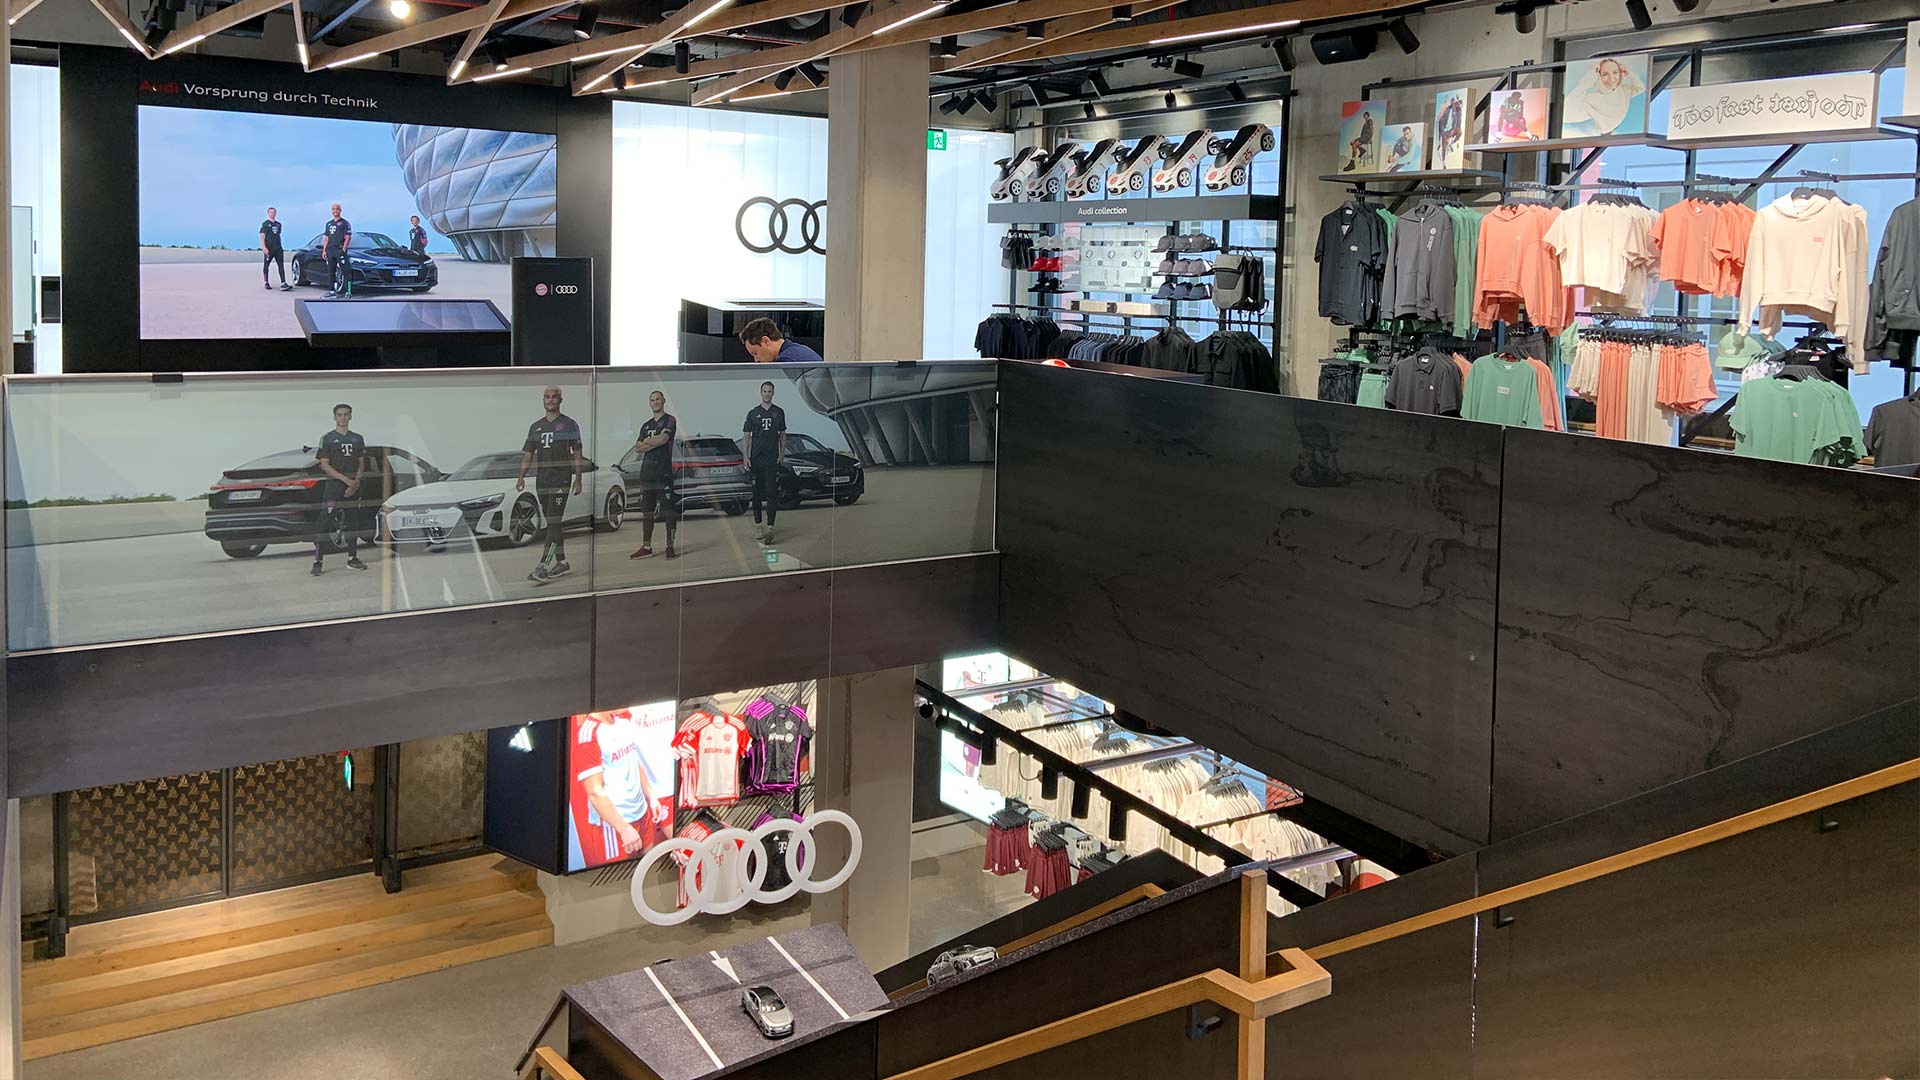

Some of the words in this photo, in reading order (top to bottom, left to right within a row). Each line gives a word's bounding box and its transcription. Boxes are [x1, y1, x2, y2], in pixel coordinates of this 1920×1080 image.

[183, 83, 269, 102] Vorsprung
[273, 90, 317, 104] durch
[321, 94, 378, 109] Technik
[1673, 104, 1714, 130] Too
[1715, 94, 1764, 124] fast
[1143, 155, 1152, 165] 13
[1188, 153, 1198, 163] 19
[1243, 148, 1253, 160] 25
[1077, 206, 1094, 215] Audi
[1095, 205, 1128, 215] collection
[761, 417, 772, 431] T
[541, 431, 554, 449] T
[341, 443, 353, 457] T
[703, 746, 723, 754] Allianz
[778, 841, 788, 854] T
